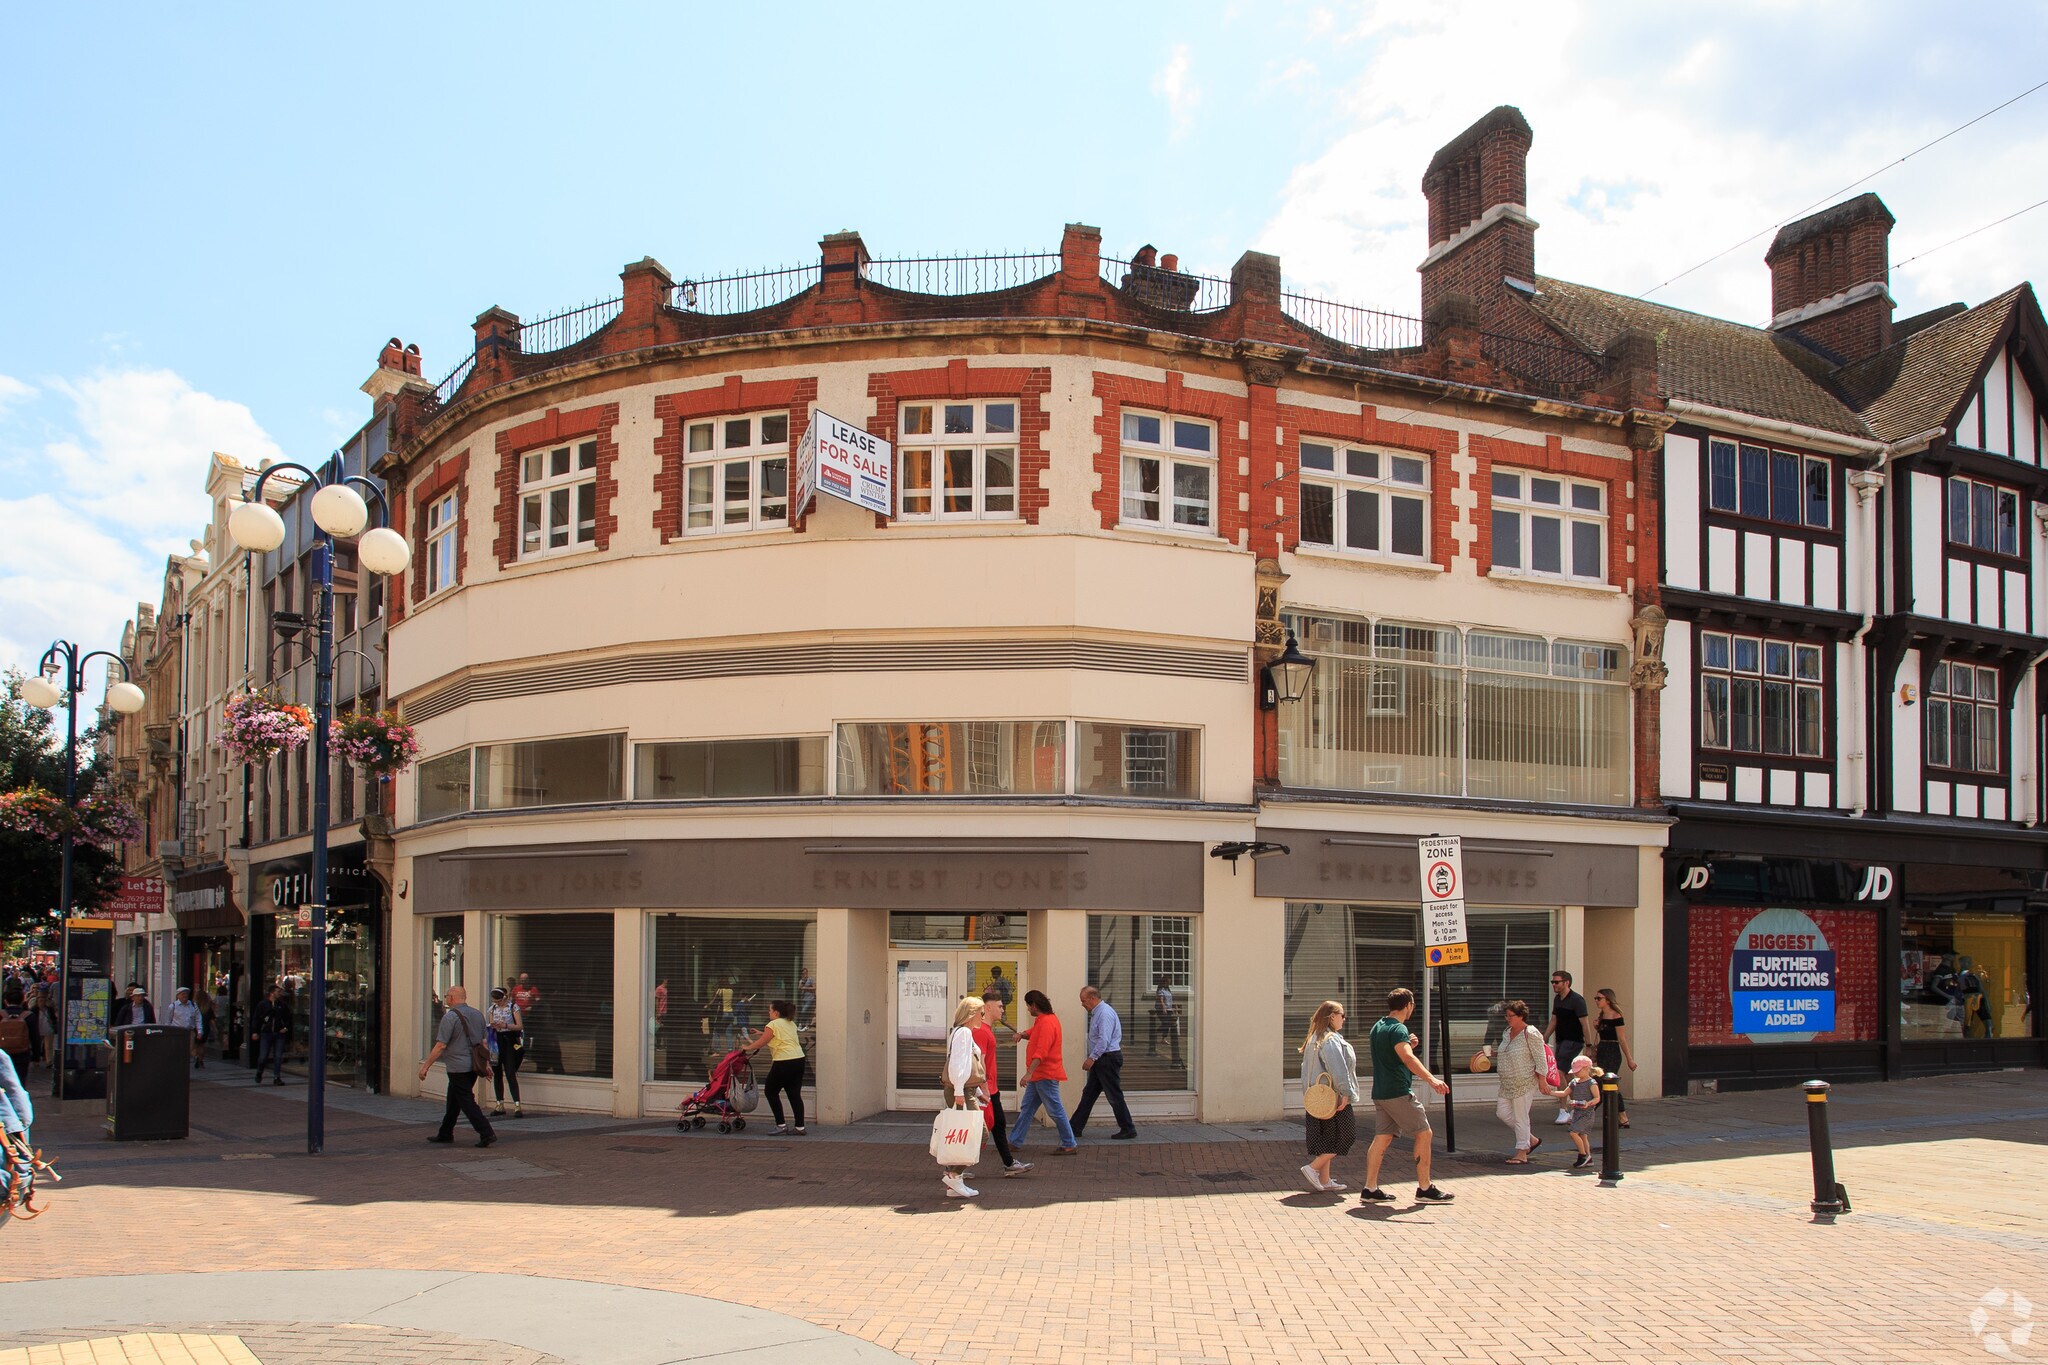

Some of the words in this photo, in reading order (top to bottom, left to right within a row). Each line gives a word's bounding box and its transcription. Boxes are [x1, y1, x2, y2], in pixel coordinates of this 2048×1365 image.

[832, 423, 876, 455] LEASE
[820, 439, 849, 464] FOR
[852, 454, 888, 480] SALE
[860, 486, 886, 502] WINTER
[861, 480, 885, 493] CRUMP
[1420, 839, 1459, 847] PEDESTRIAN
[1426, 847, 1454, 859] ZONE
[813, 870, 948, 890] ERNEST
[975, 870, 1088, 890] JONES
[1319, 861, 1412, 884] ERNES
[1467, 866, 1538, 888] ONES
[1680, 866, 1709, 890] JD
[127, 881, 144, 890] Let
[273, 873, 330, 906] OFFI
[1858, 866, 1893, 900] JD
[111, 902, 137, 911] Knight
[139, 902, 161, 910] Frank
[1429, 904, 1449, 912] Except
[1748, 934, 1816, 950] BIGGEST
[1449, 953, 1462, 961] time
[1752, 956, 1817, 971] FURTHER
[1739, 972, 1829, 987] REDUCTIONS
[1750, 999, 1784, 1012] MORE
[1786, 999, 1819, 1011] LINES
[1764, 1014, 1805, 1026] ADDED
[944, 1128, 969, 1145] H&M
